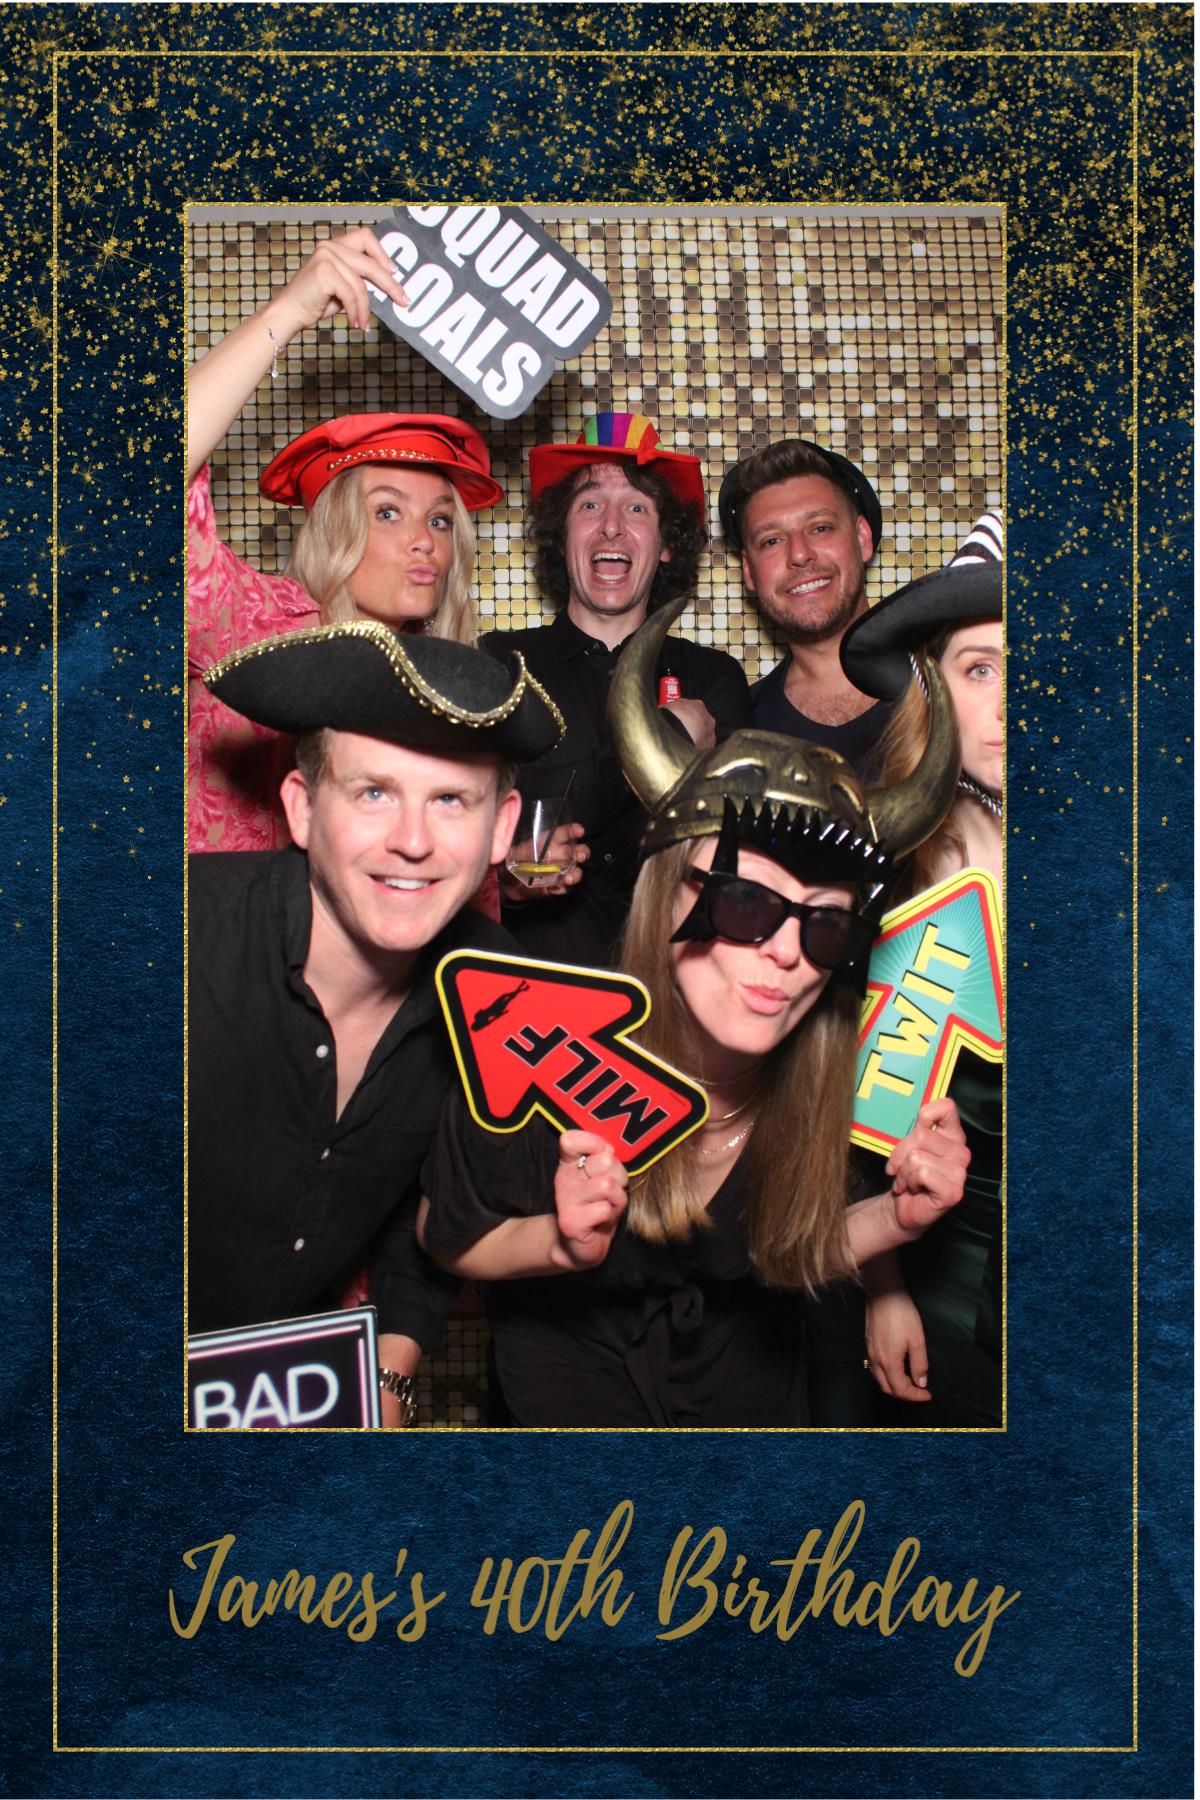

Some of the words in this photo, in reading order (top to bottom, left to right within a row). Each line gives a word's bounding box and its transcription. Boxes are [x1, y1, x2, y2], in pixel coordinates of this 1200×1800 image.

[857, 921, 971, 1100] TWIT
[503, 1024, 669, 1147] MILF
[194, 1363, 340, 1428] BAD
